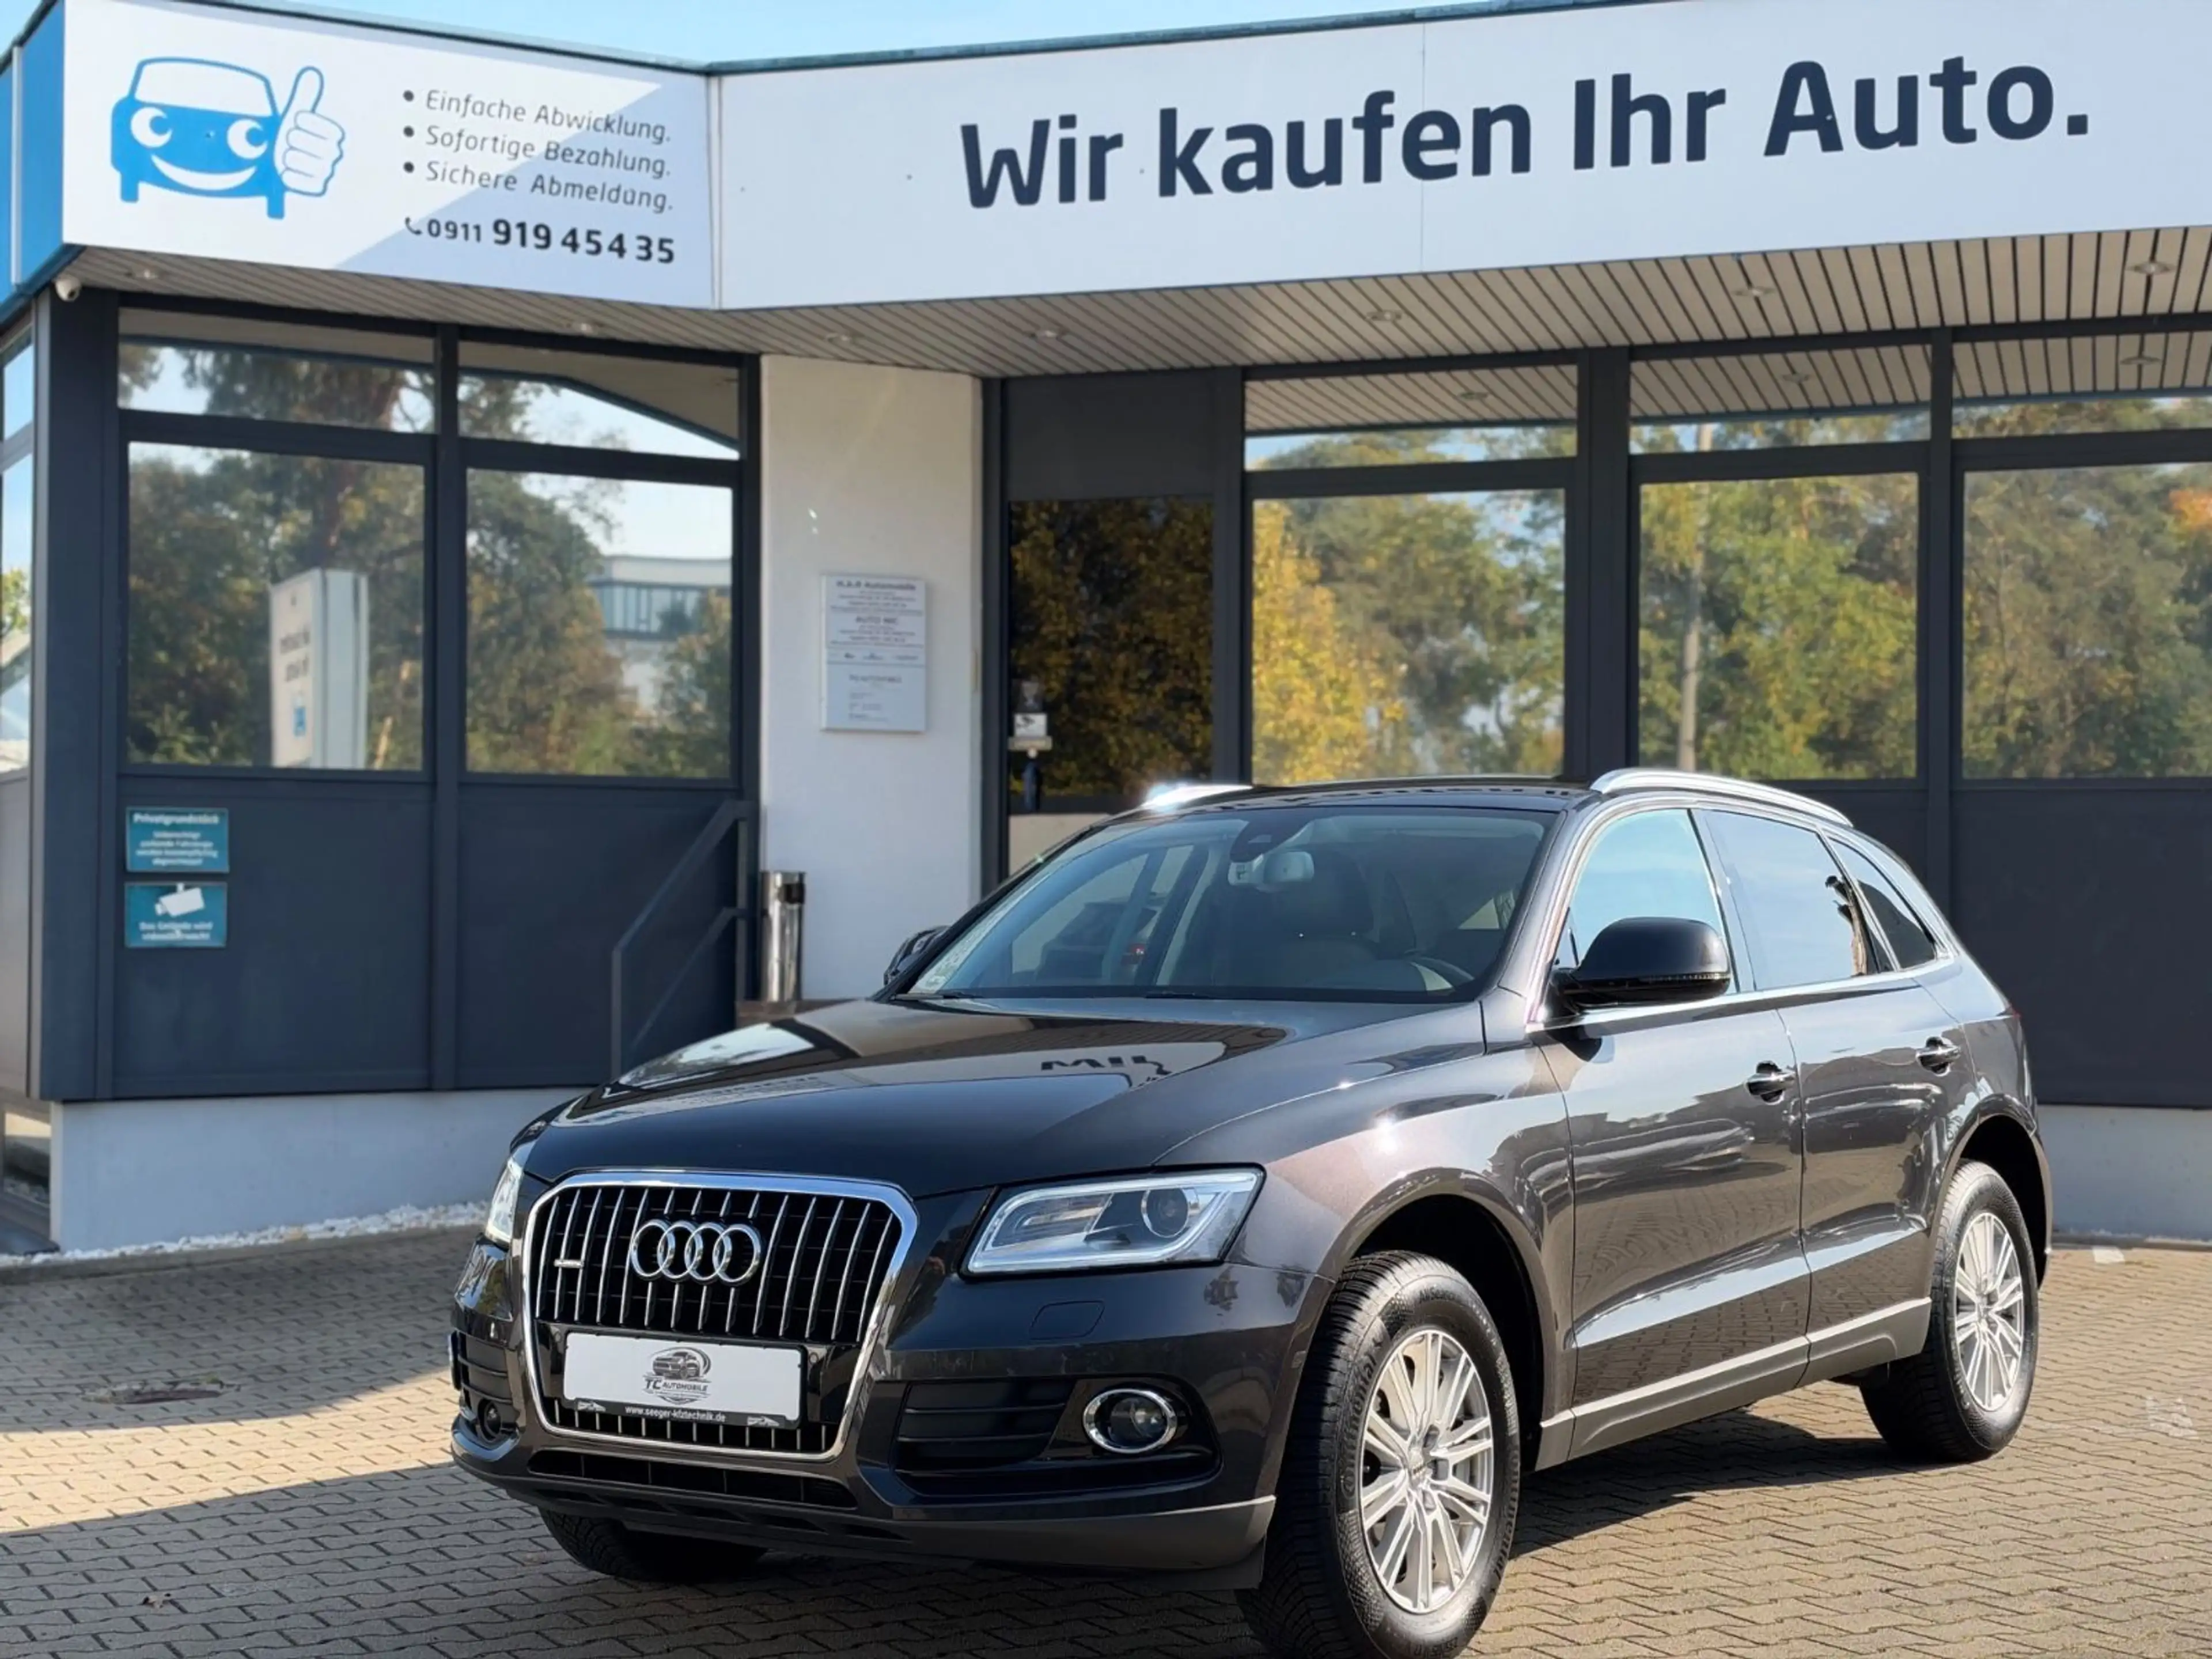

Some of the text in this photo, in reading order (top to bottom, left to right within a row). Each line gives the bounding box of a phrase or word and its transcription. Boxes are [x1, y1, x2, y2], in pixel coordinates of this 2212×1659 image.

[426, 89, 671, 145] Einfache Abwicklung.
[961, 56, 2088, 209] Wir kaufen Ihr Auto.
[426, 125, 671, 180] Sofortige Bezahlung.
[426, 161, 673, 214] Sichere Abmeldung.
[427, 218, 482, 243] 0911
[493, 218, 552, 251] 919
[645, 1378, 662, 1390] TC
